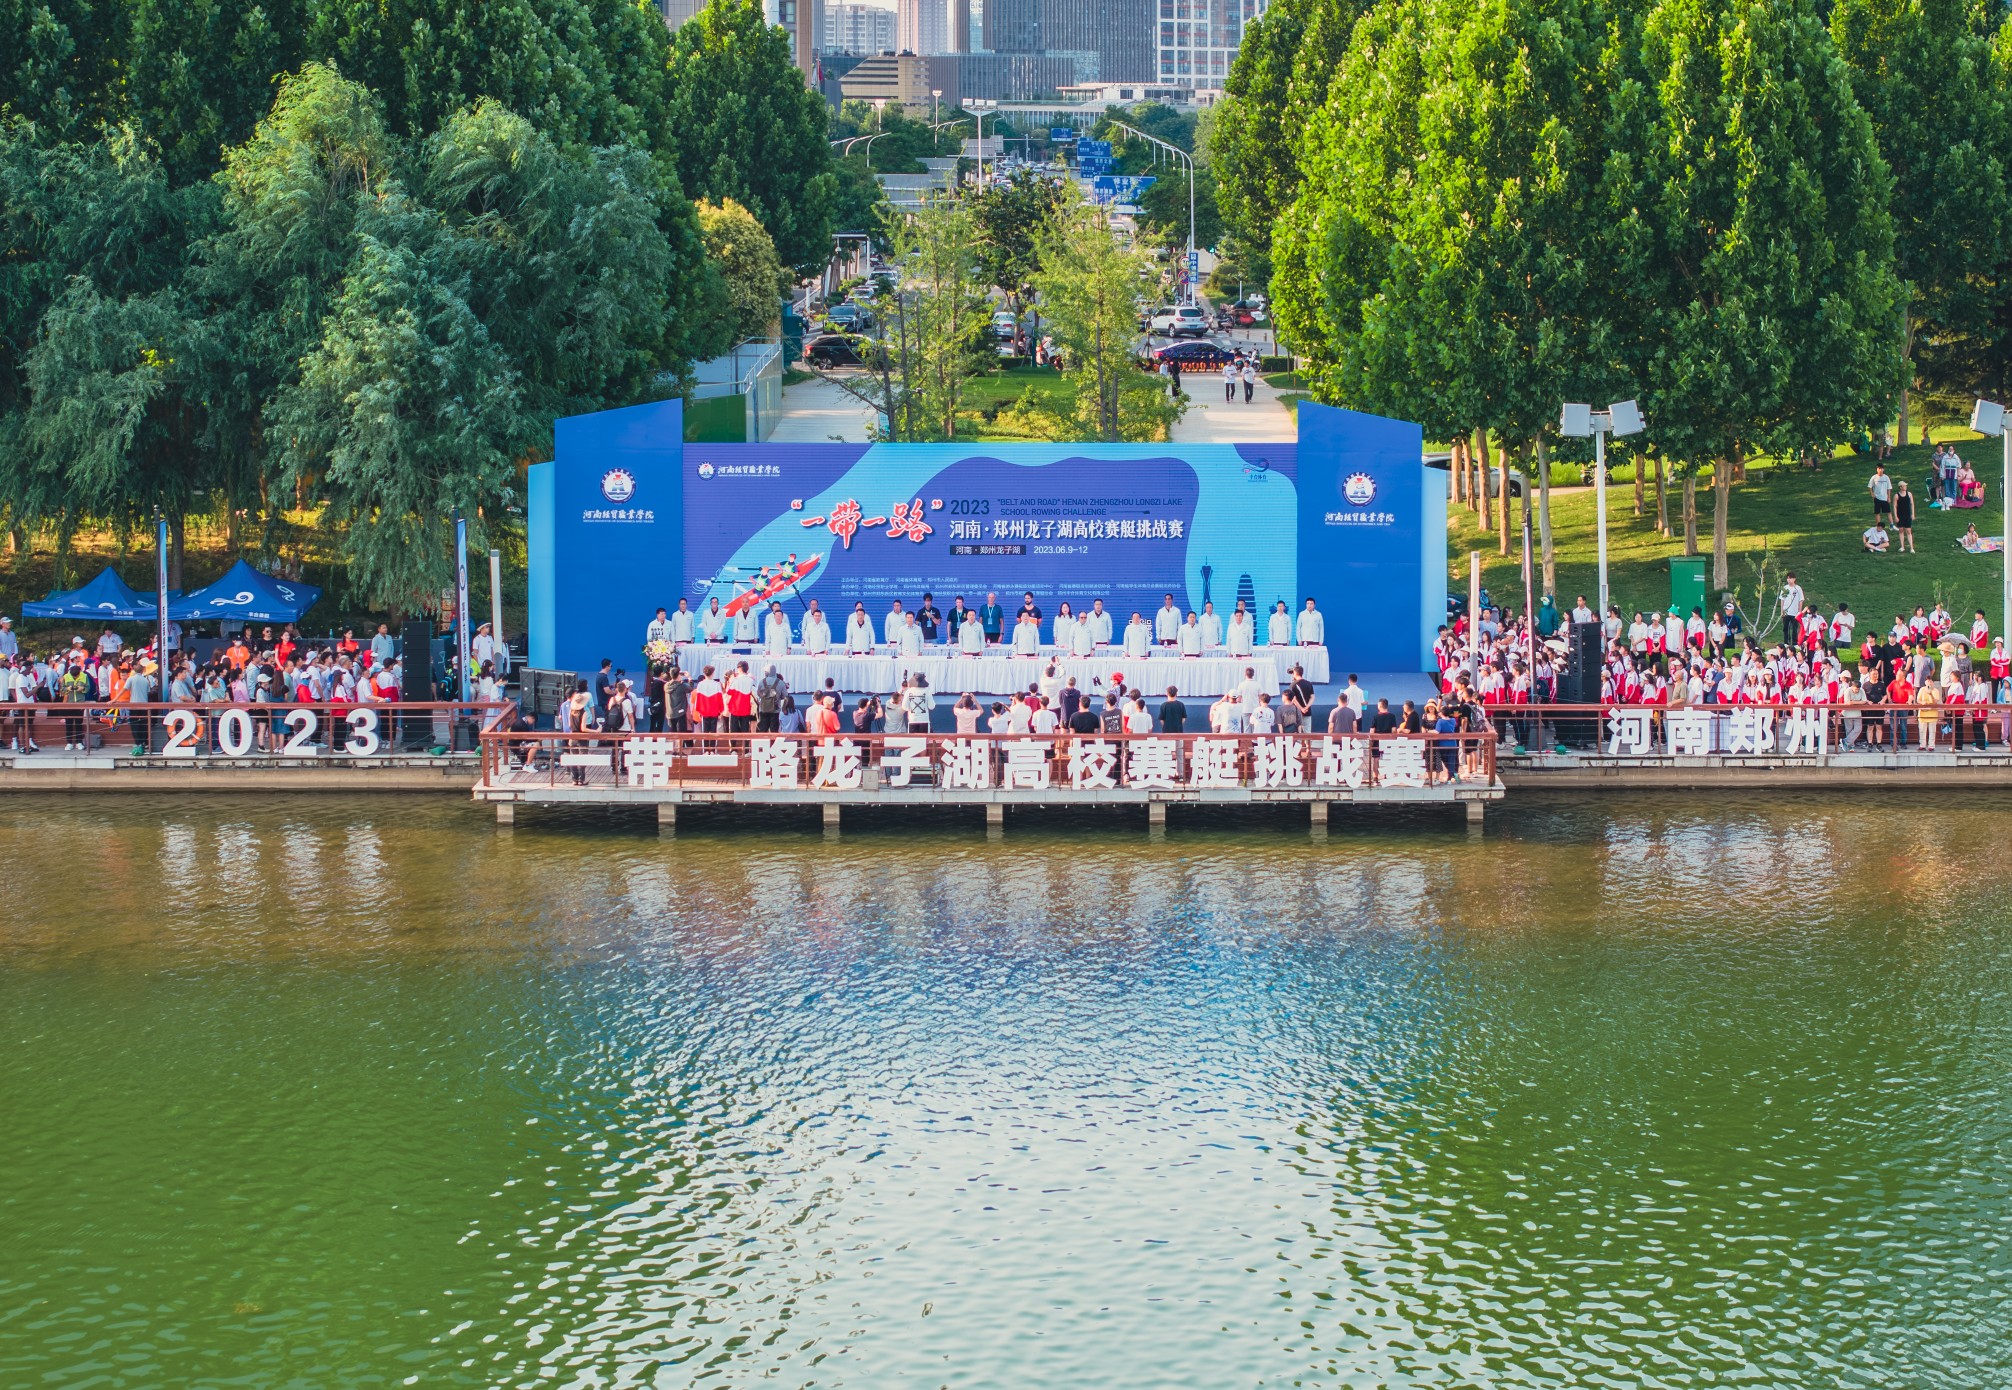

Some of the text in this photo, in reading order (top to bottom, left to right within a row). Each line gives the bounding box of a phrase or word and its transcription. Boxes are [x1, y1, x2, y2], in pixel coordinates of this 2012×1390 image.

[950, 500, 990, 515] 2023
[1020, 498, 1035, 506] AND
[1062, 498, 1088, 506] HENAN
[1090, 498, 1133, 506] ZHENGZHOU
[1135, 498, 1161, 506] LONGZI
[1163, 498, 1183, 506] LAKE
[1001, 508, 1106, 516] SCHOOL ROWING CHALLENGE
[1033, 546, 1088, 554] 2023.06.9-12
[162, 708, 379, 757] 2023
[1607, 706, 1829, 756] 河南郑州
[560, 736, 1427, 789] 一带一路龙子湖高校赛艇挑战赛
